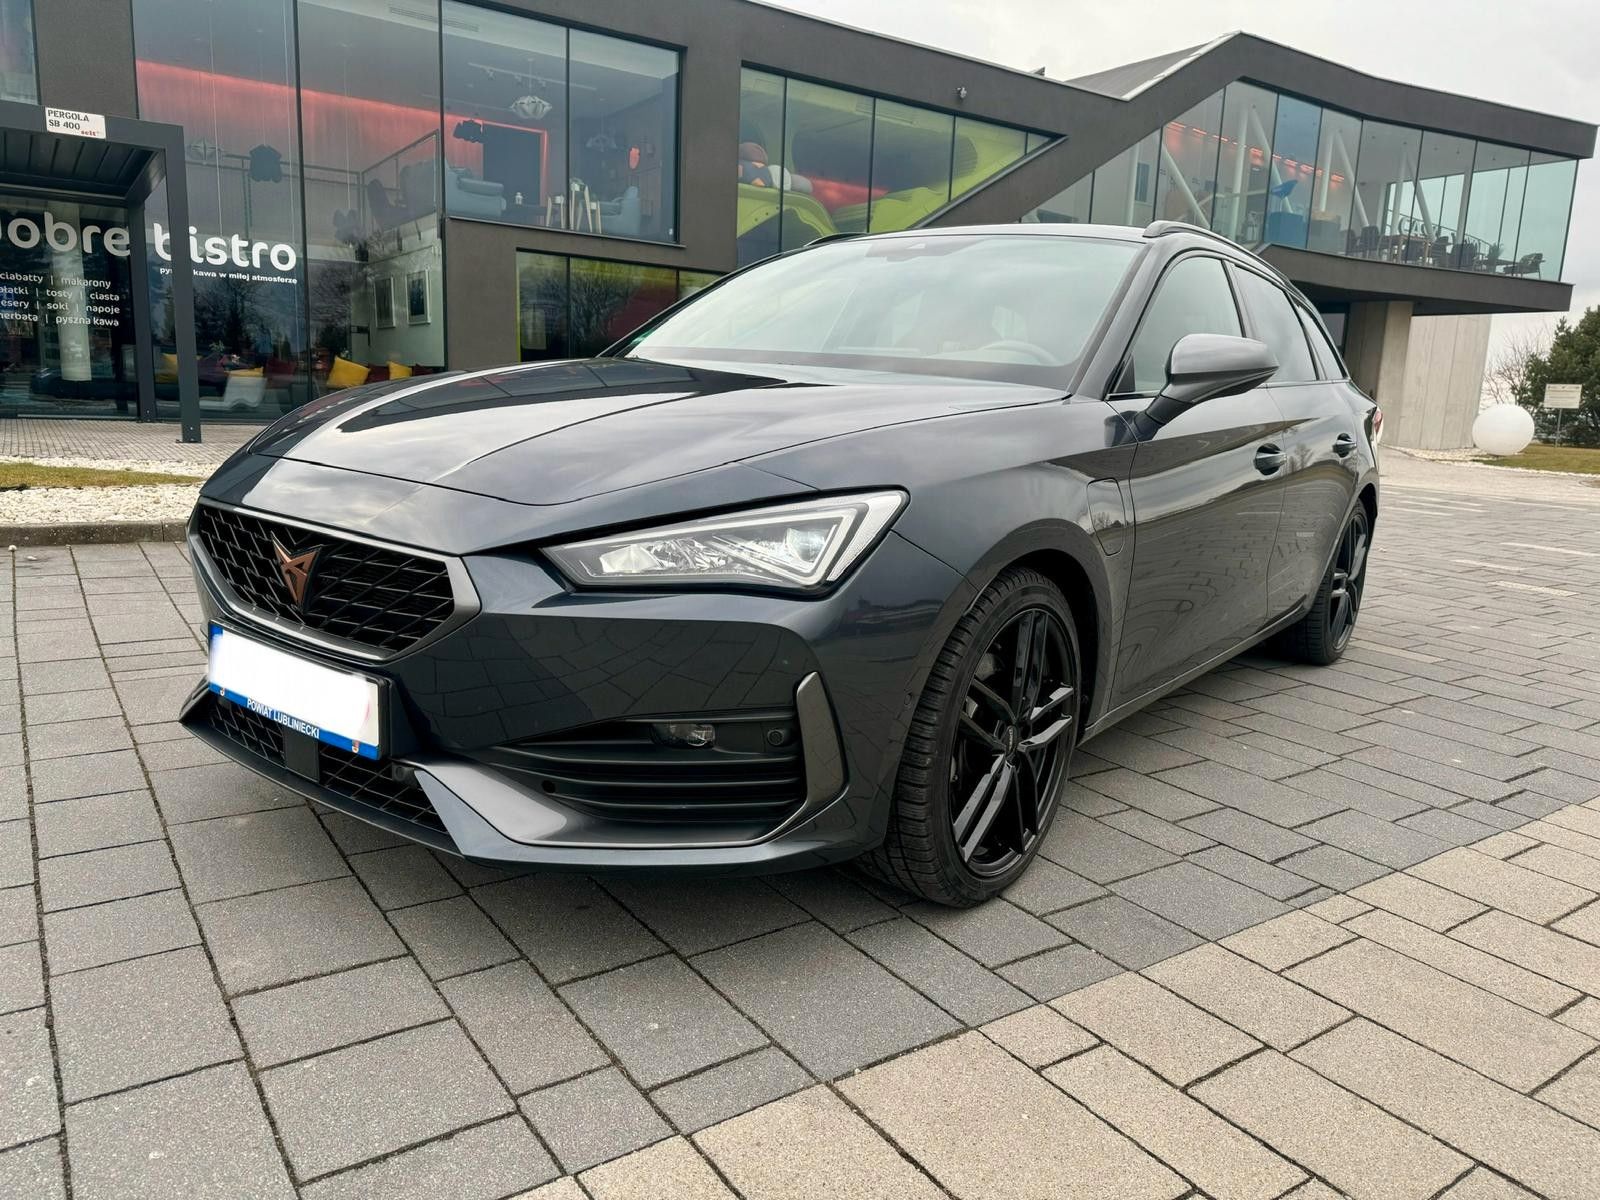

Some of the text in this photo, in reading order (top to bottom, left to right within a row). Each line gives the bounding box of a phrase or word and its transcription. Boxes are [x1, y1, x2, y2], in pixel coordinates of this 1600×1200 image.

[47, 109, 90, 122] PERGOLA
[49, 119, 81, 130] SB 400
[0, 211, 131, 257] obre
[0, 271, 111, 289] ciabatty makarony
[193, 269, 217, 278] kawa
[252, 275, 298, 284] atmosferze
[0, 286, 120, 302] ałatki tosty ciasta
[0, 299, 120, 315] esery soki napoje
[55, 316, 91, 325] pyszna
[93, 317, 120, 326] kawa
[246, 698, 320, 739] POWIAT LUBLINIECKI
